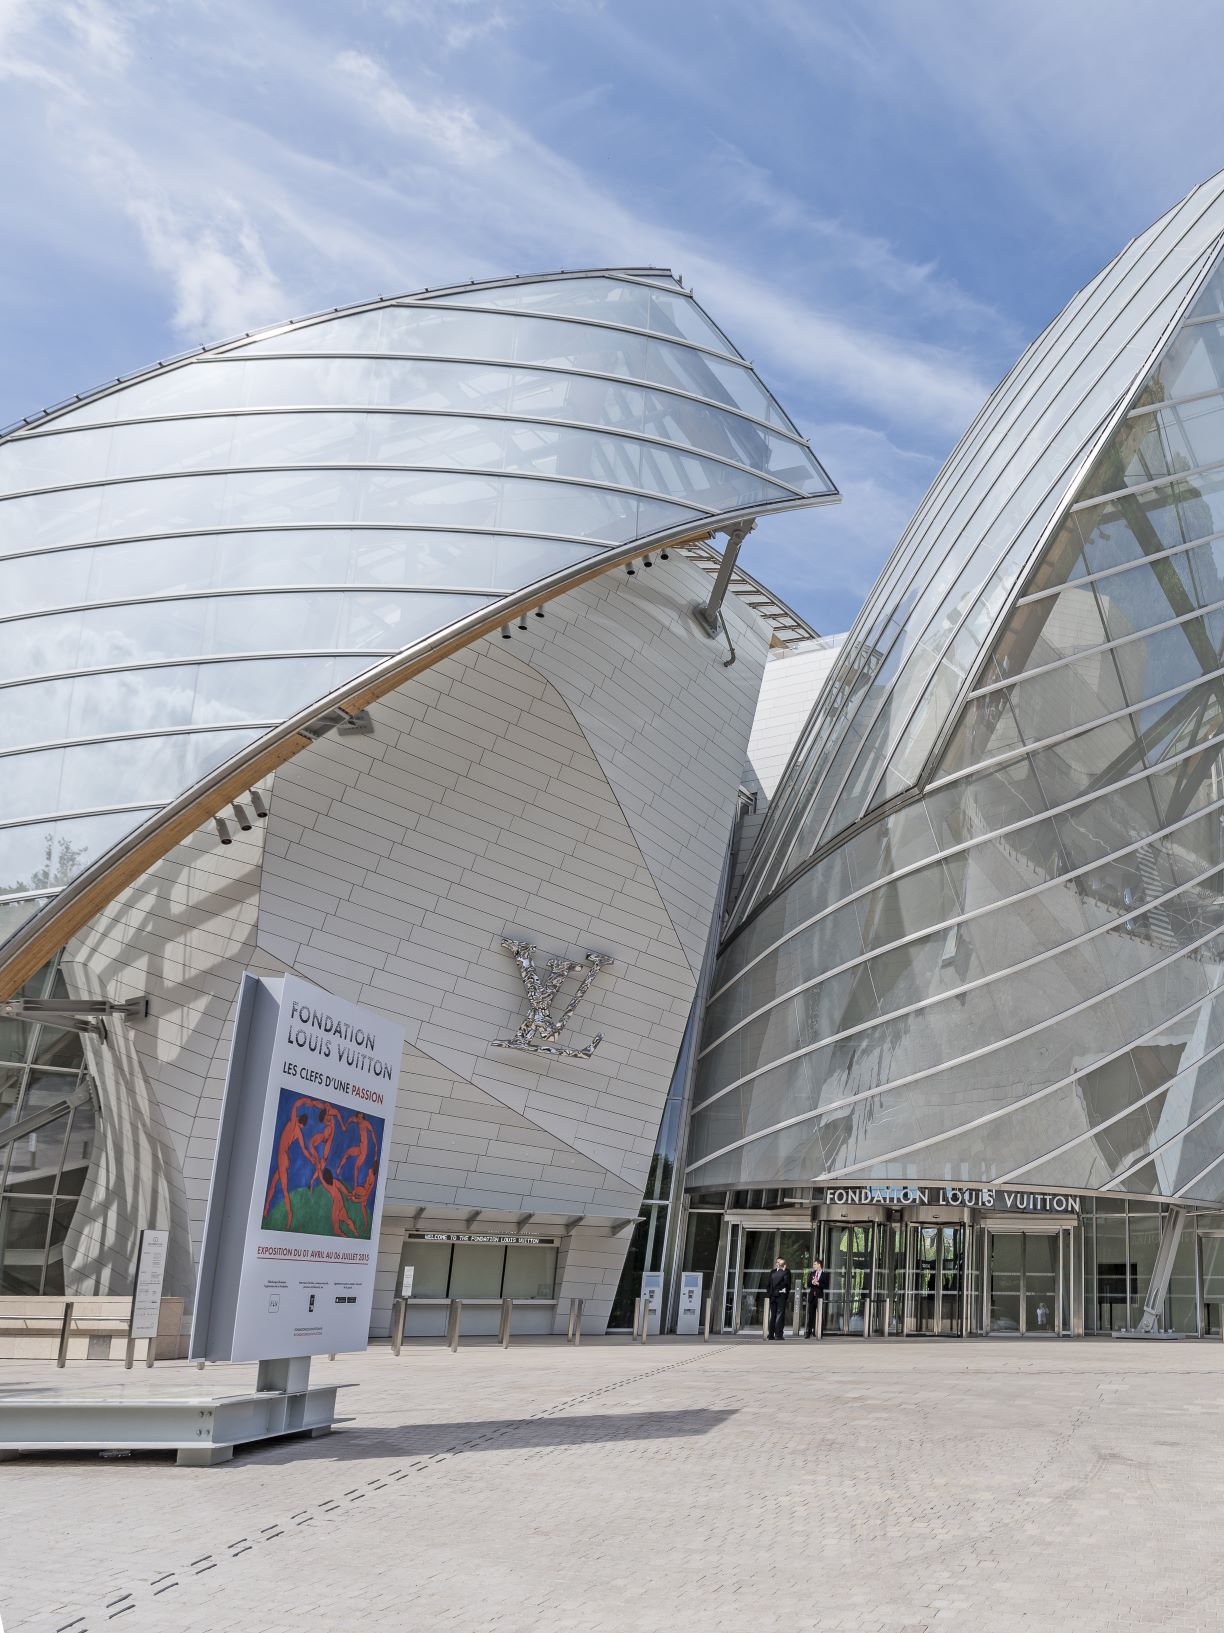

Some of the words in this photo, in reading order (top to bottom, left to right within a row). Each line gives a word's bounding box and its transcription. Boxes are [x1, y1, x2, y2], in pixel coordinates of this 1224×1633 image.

[291, 1001, 376, 1051] FONDATION
[288, 1025, 331, 1057] LOUIS
[337, 1043, 392, 1080] VUITTON
[283, 1061, 298, 1077] LES
[300, 1067, 323, 1085] CLEFS
[325, 1075, 350, 1094] D'UNE
[352, 1084, 384, 1105] PASSION
[827, 1189, 929, 1205] FONDATION
[939, 1189, 994, 1206] LOUIS
[1004, 1192, 1081, 1212] VUITTON
[257, 1246, 293, 1257] EXPOSITION
[293, 1249, 302, 1257] DU
[310, 1250, 325, 1259] AVRIL
[334, 1252, 341, 1260] 06
[341, 1253, 358, 1261] JUILLET
[358, 1254, 370, 1262] 2015
